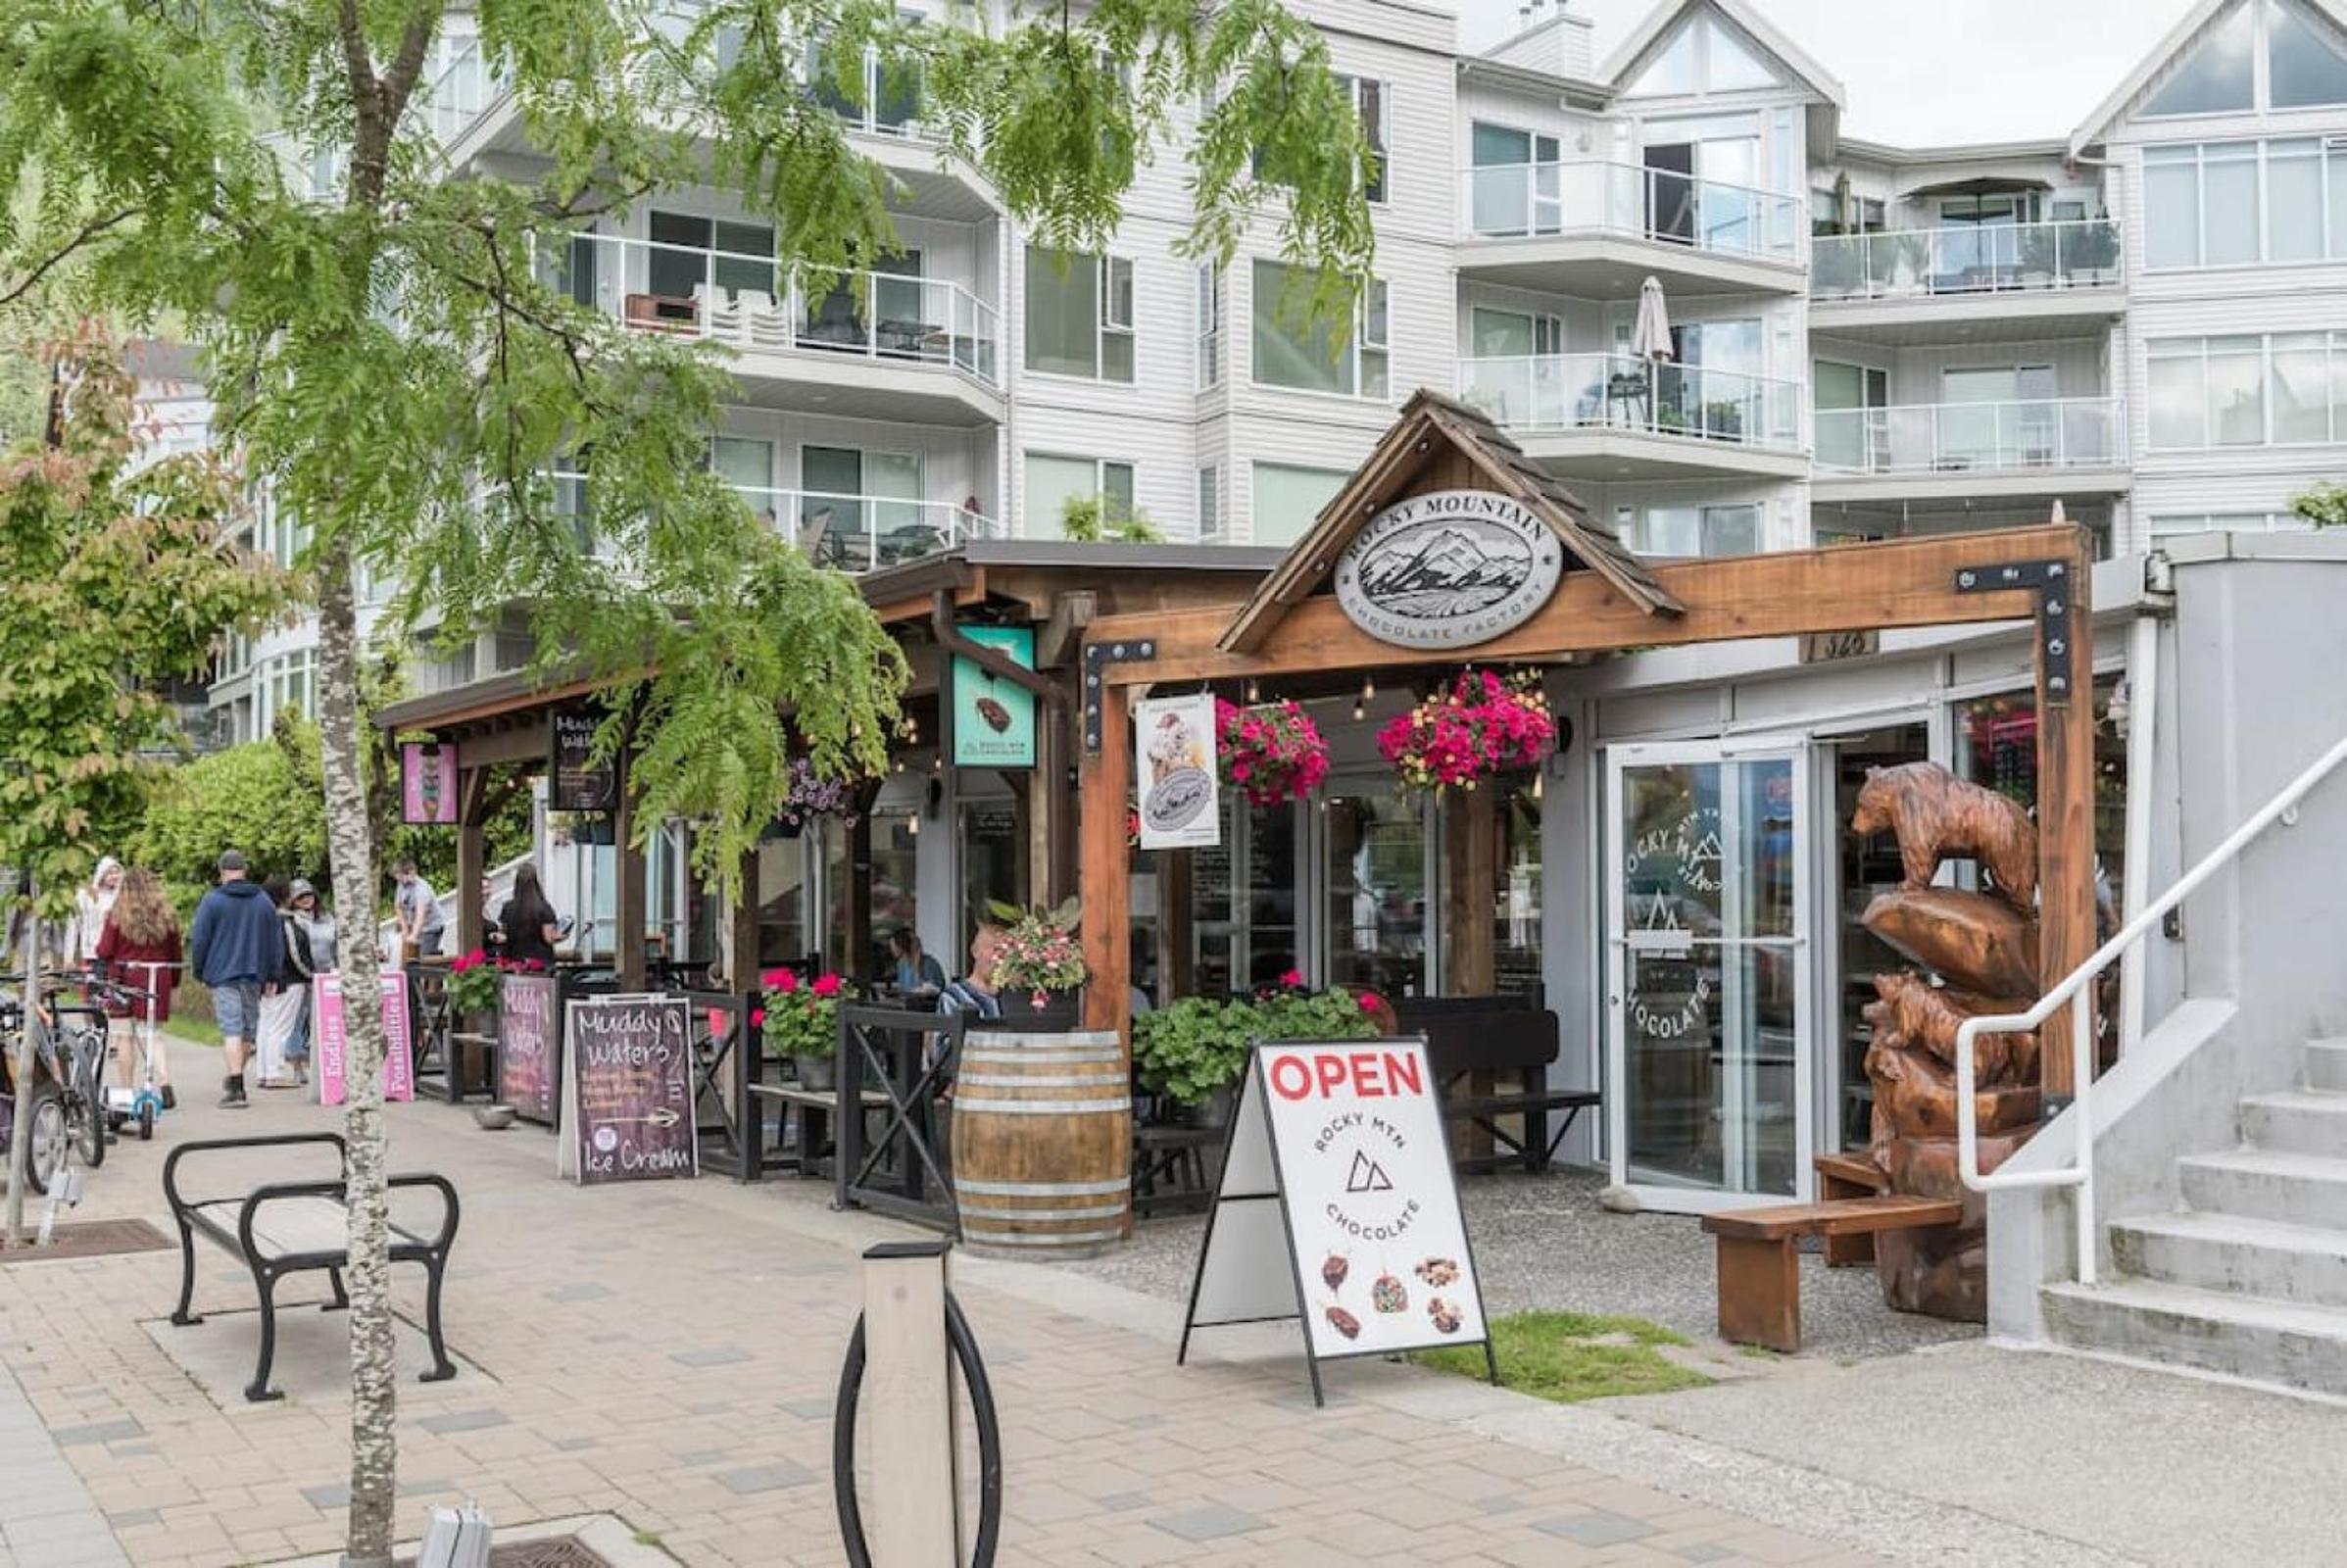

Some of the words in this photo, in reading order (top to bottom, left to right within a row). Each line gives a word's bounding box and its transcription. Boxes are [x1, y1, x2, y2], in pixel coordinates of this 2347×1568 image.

[1348, 505, 1413, 560] ROCKY
[1426, 495, 1547, 541] MOUNTAIN
[1347, 596, 1451, 640] CHOCOLATE
[1463, 582, 1541, 633] FACTORY
[1627, 828, 1669, 874] OCKY
[578, 1008, 661, 1047] Muddy
[1627, 976, 1710, 1038] HOCOLATE
[1269, 1052, 1423, 1102] OPEN
[1313, 1111, 1364, 1153] ROCKY
[1371, 1115, 1406, 1151] MTN
[585, 1141, 614, 1173] Ice
[620, 1139, 690, 1170] Cream
[1325, 1199, 1421, 1242] CHOCOLATE
